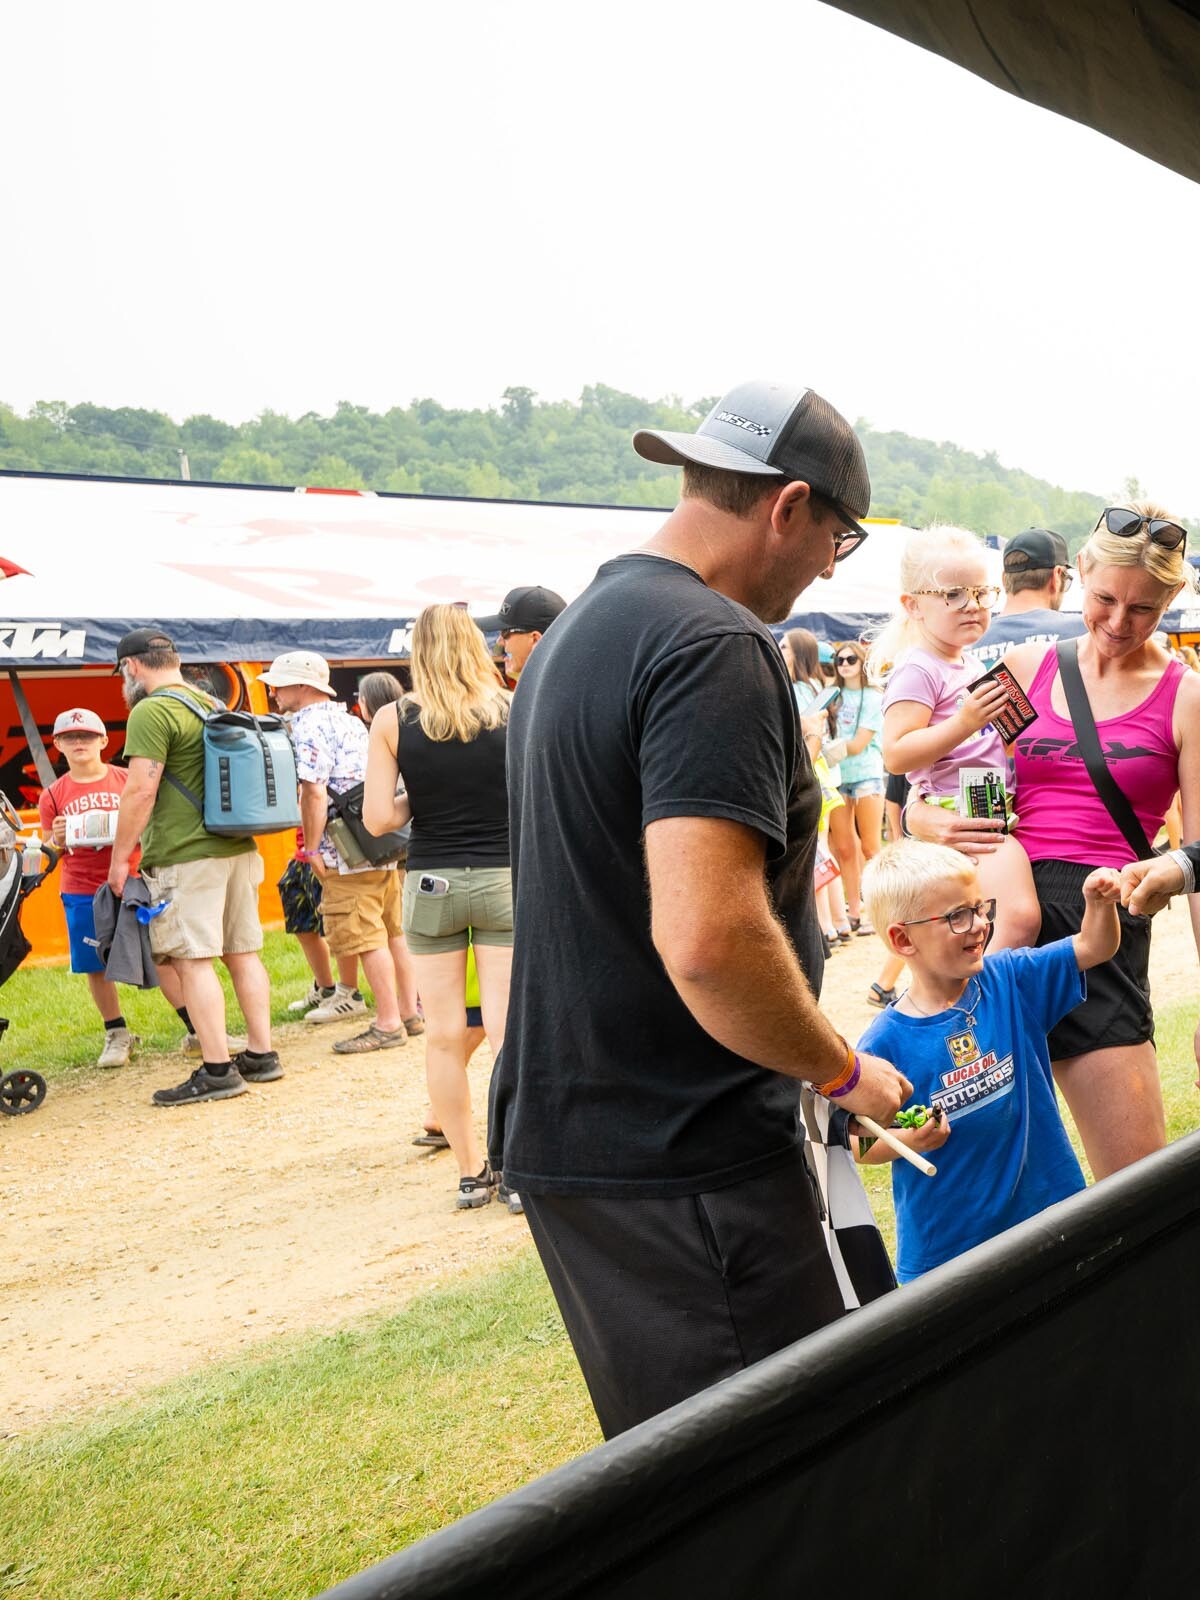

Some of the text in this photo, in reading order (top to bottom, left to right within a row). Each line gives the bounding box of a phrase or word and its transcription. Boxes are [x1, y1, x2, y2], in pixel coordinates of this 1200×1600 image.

[0, 621, 86, 658] TM
[951, 1035, 973, 1054] 50
[946, 1062, 980, 1086] LUCAS
[981, 1053, 996, 1069] OIL
[962, 1070, 988, 1086] PRO
